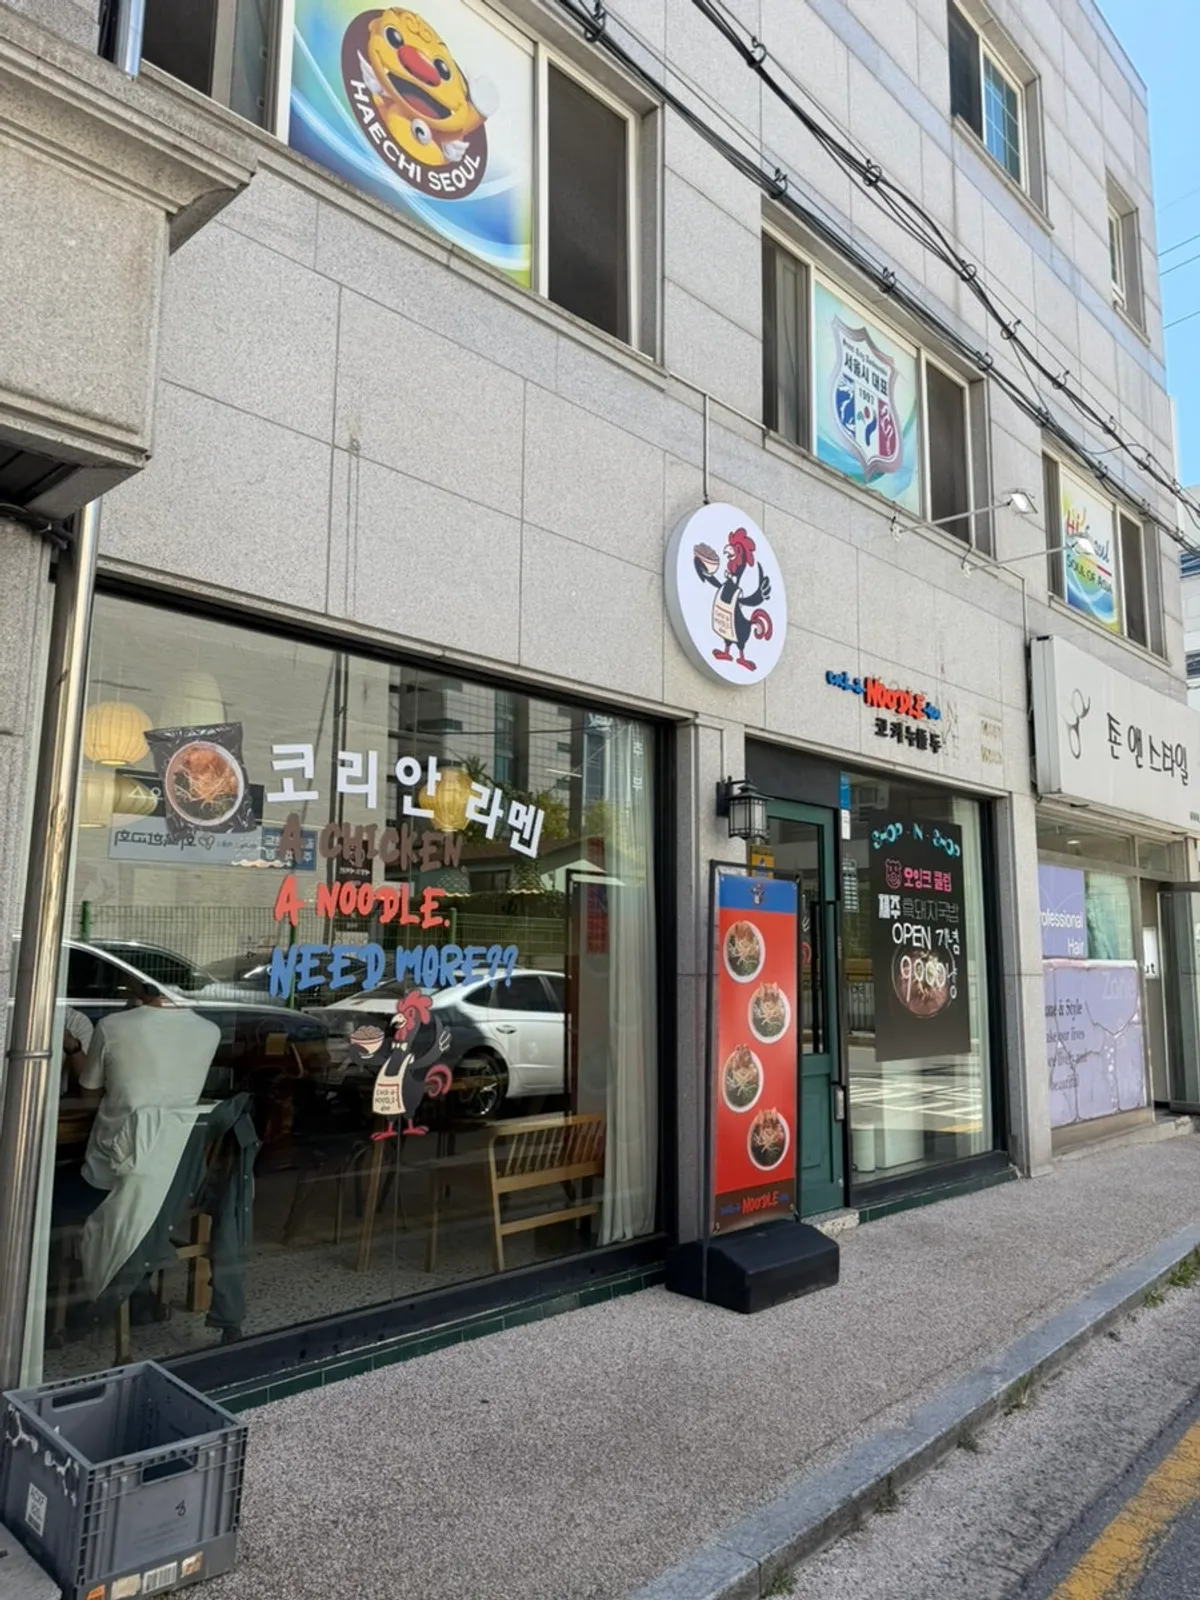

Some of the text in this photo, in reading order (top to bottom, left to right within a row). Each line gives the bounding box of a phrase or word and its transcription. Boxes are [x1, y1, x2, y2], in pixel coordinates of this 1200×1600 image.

[350, 79, 482, 192] HAECHI SEOUL
[844, 353, 870, 384] 서울시
[863, 677, 926, 720] NOODLE
[1107, 712, 1122, 760] 톤
[1149, 734, 1188, 787] 스타일
[267, 743, 546, 858] 코리안 라멘
[279, 812, 304, 863] A
[903, 867, 952, 893] 오잉크 클럽
[274, 874, 450, 930] A NOODLE.
[877, 893, 901, 919] 제주
[891, 922, 932, 951] OPEN
[1067, 937, 1084, 957] Hair
[268, 943, 519, 1000] NEED MORE??
[741, 1190, 780, 1215] NOODLE
